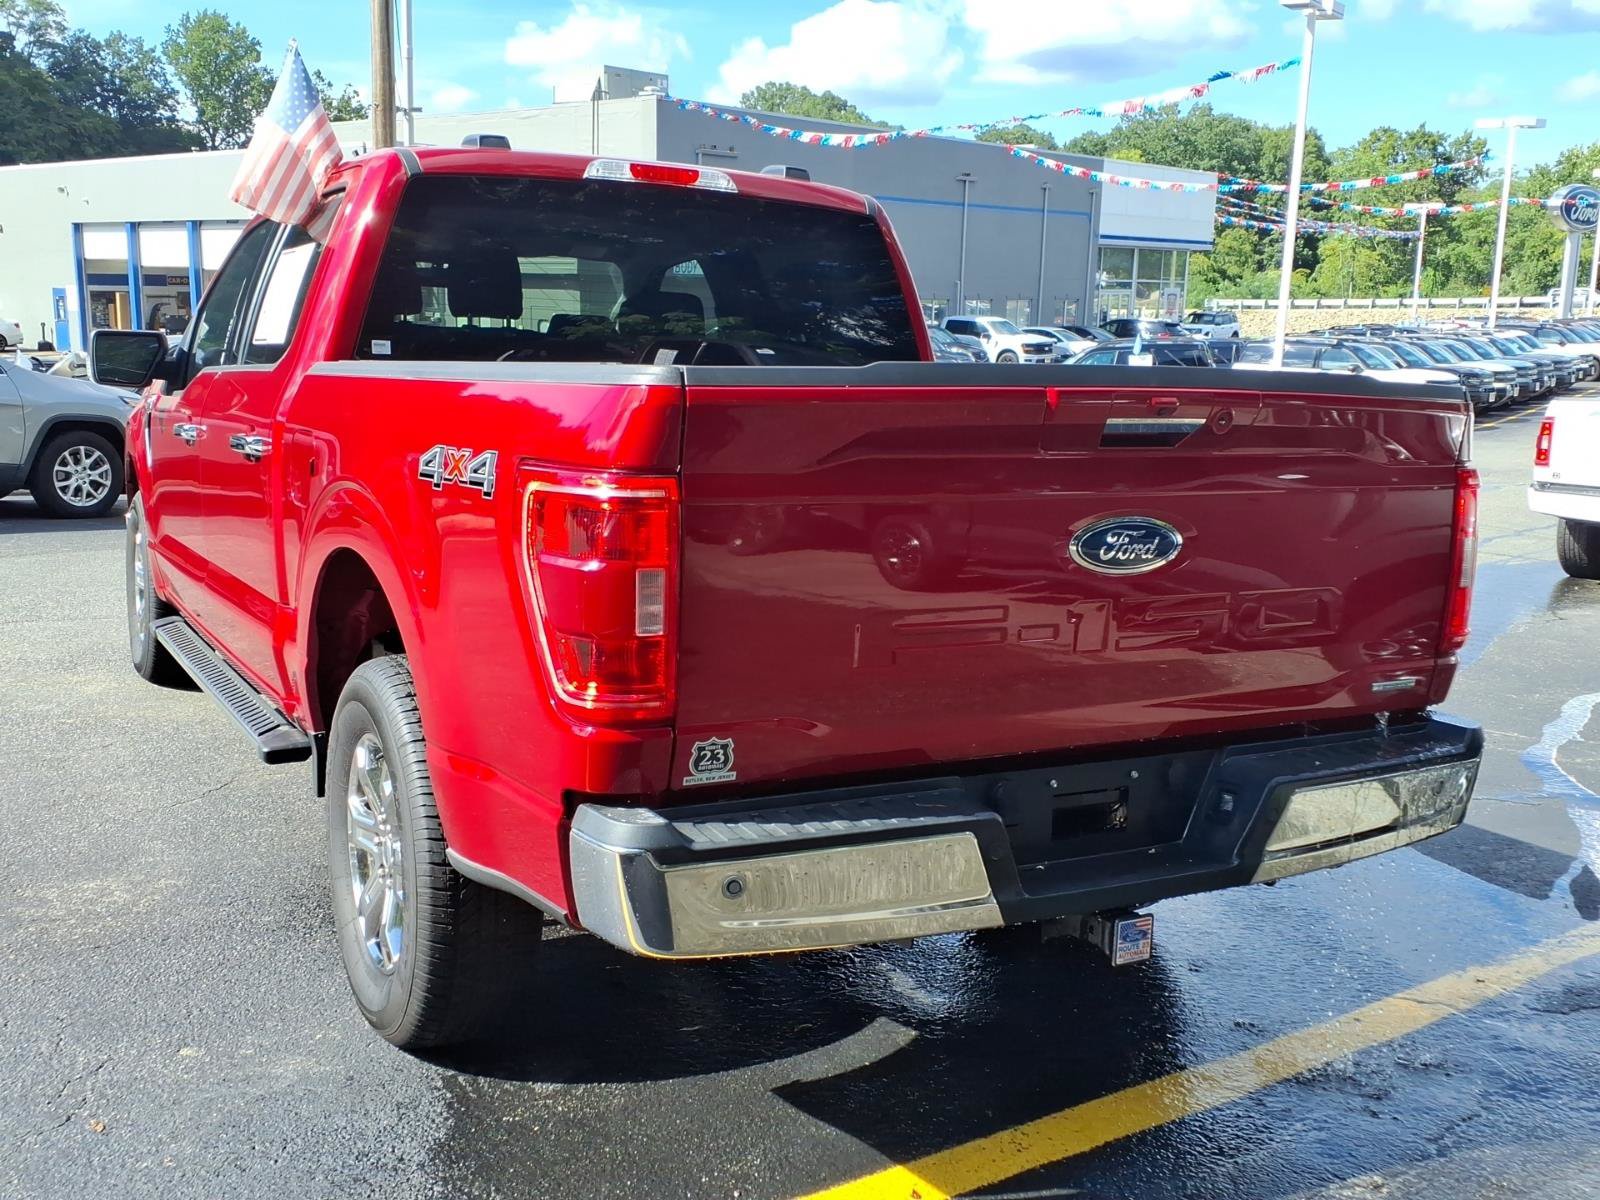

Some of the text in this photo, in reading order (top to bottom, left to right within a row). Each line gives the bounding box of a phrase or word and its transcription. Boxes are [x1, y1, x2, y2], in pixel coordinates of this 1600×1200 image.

[1099, 528, 1160, 561] Ford
[699, 749, 725, 766] 23
[1119, 944, 1140, 952] ROUTE
[1119, 949, 1148, 958] AUTOMALL
